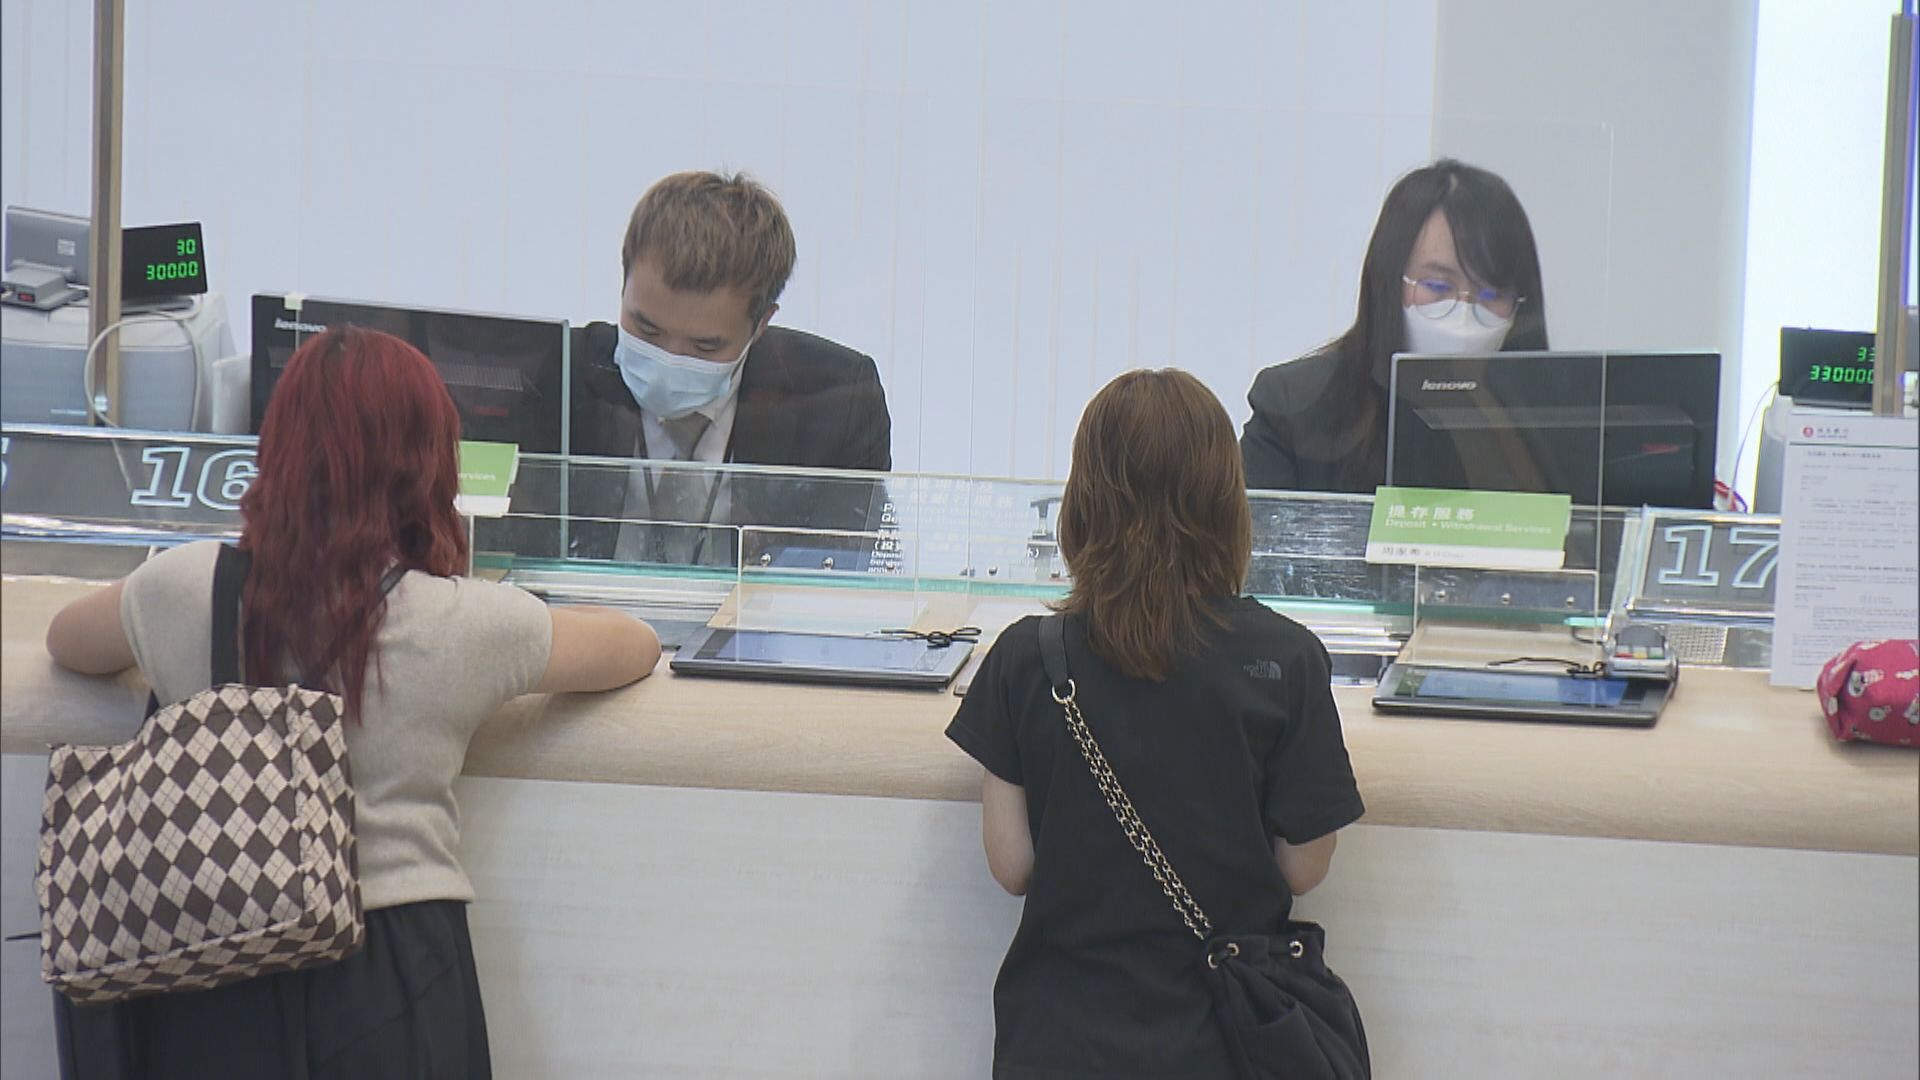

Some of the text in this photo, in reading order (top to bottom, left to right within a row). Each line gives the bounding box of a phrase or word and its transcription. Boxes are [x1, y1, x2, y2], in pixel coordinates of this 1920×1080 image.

[177, 239, 196, 256] 30
[146, 261, 199, 281] 30000
[1421, 379, 1477, 390] lenovo
[130, 447, 258, 510] 16
[1657, 524, 1781, 588] 17
